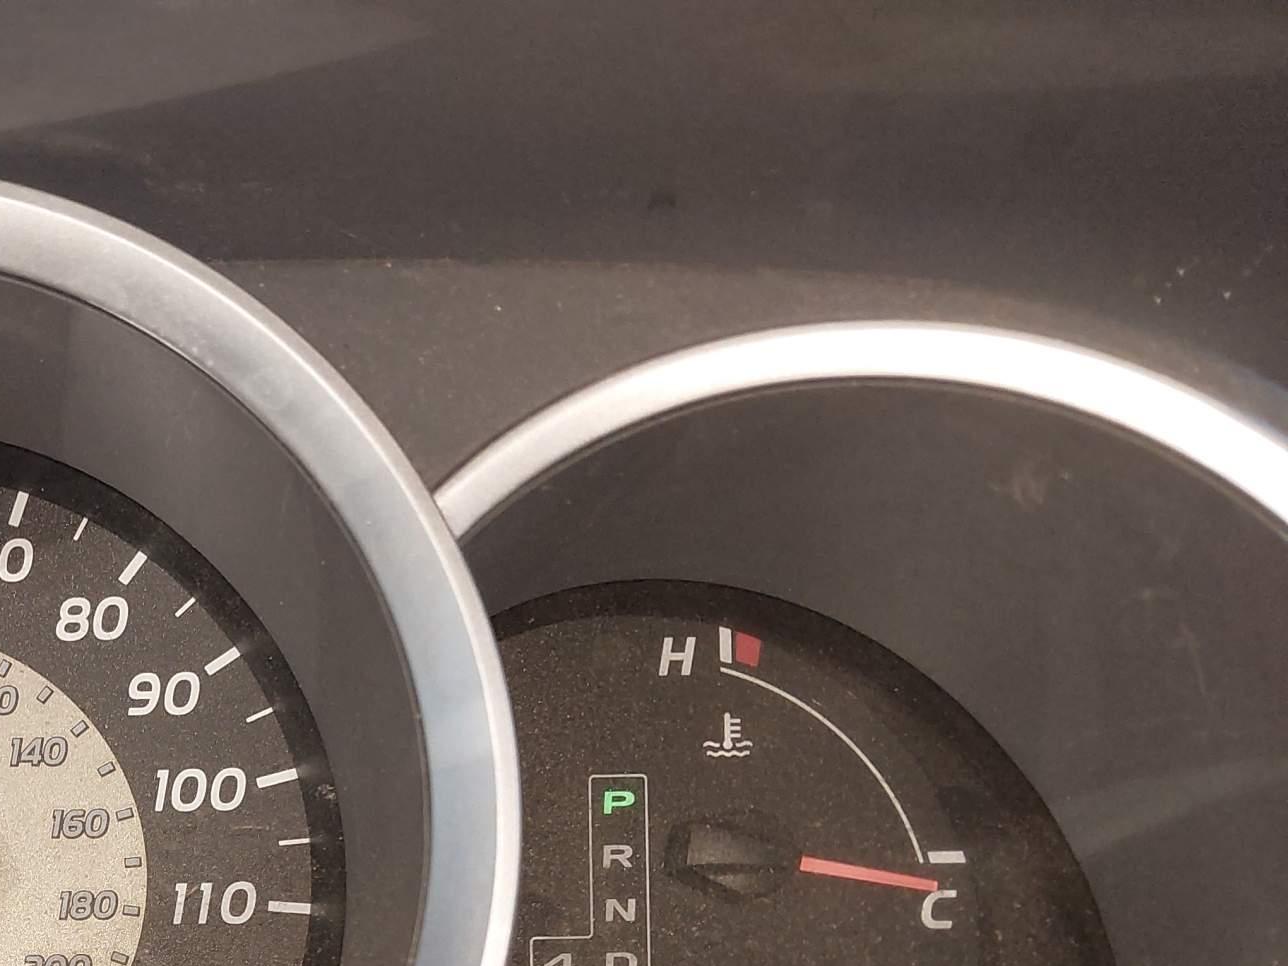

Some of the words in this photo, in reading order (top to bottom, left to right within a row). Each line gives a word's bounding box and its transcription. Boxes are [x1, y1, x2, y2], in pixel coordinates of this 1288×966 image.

[56, 597, 128, 641] 80
[659, 637, 696, 675] H
[128, 672, 200, 716] 90
[10, 737, 67, 766] 140
[154, 768, 246, 812] 100
[603, 791, 635, 814] P
[52, 809, 109, 838] 160
[603, 846, 634, 868] R
[59, 890, 118, 920] 180
[173, 881, 257, 925] 110
[605, 899, 636, 921] N
[921, 890, 957, 929] C
